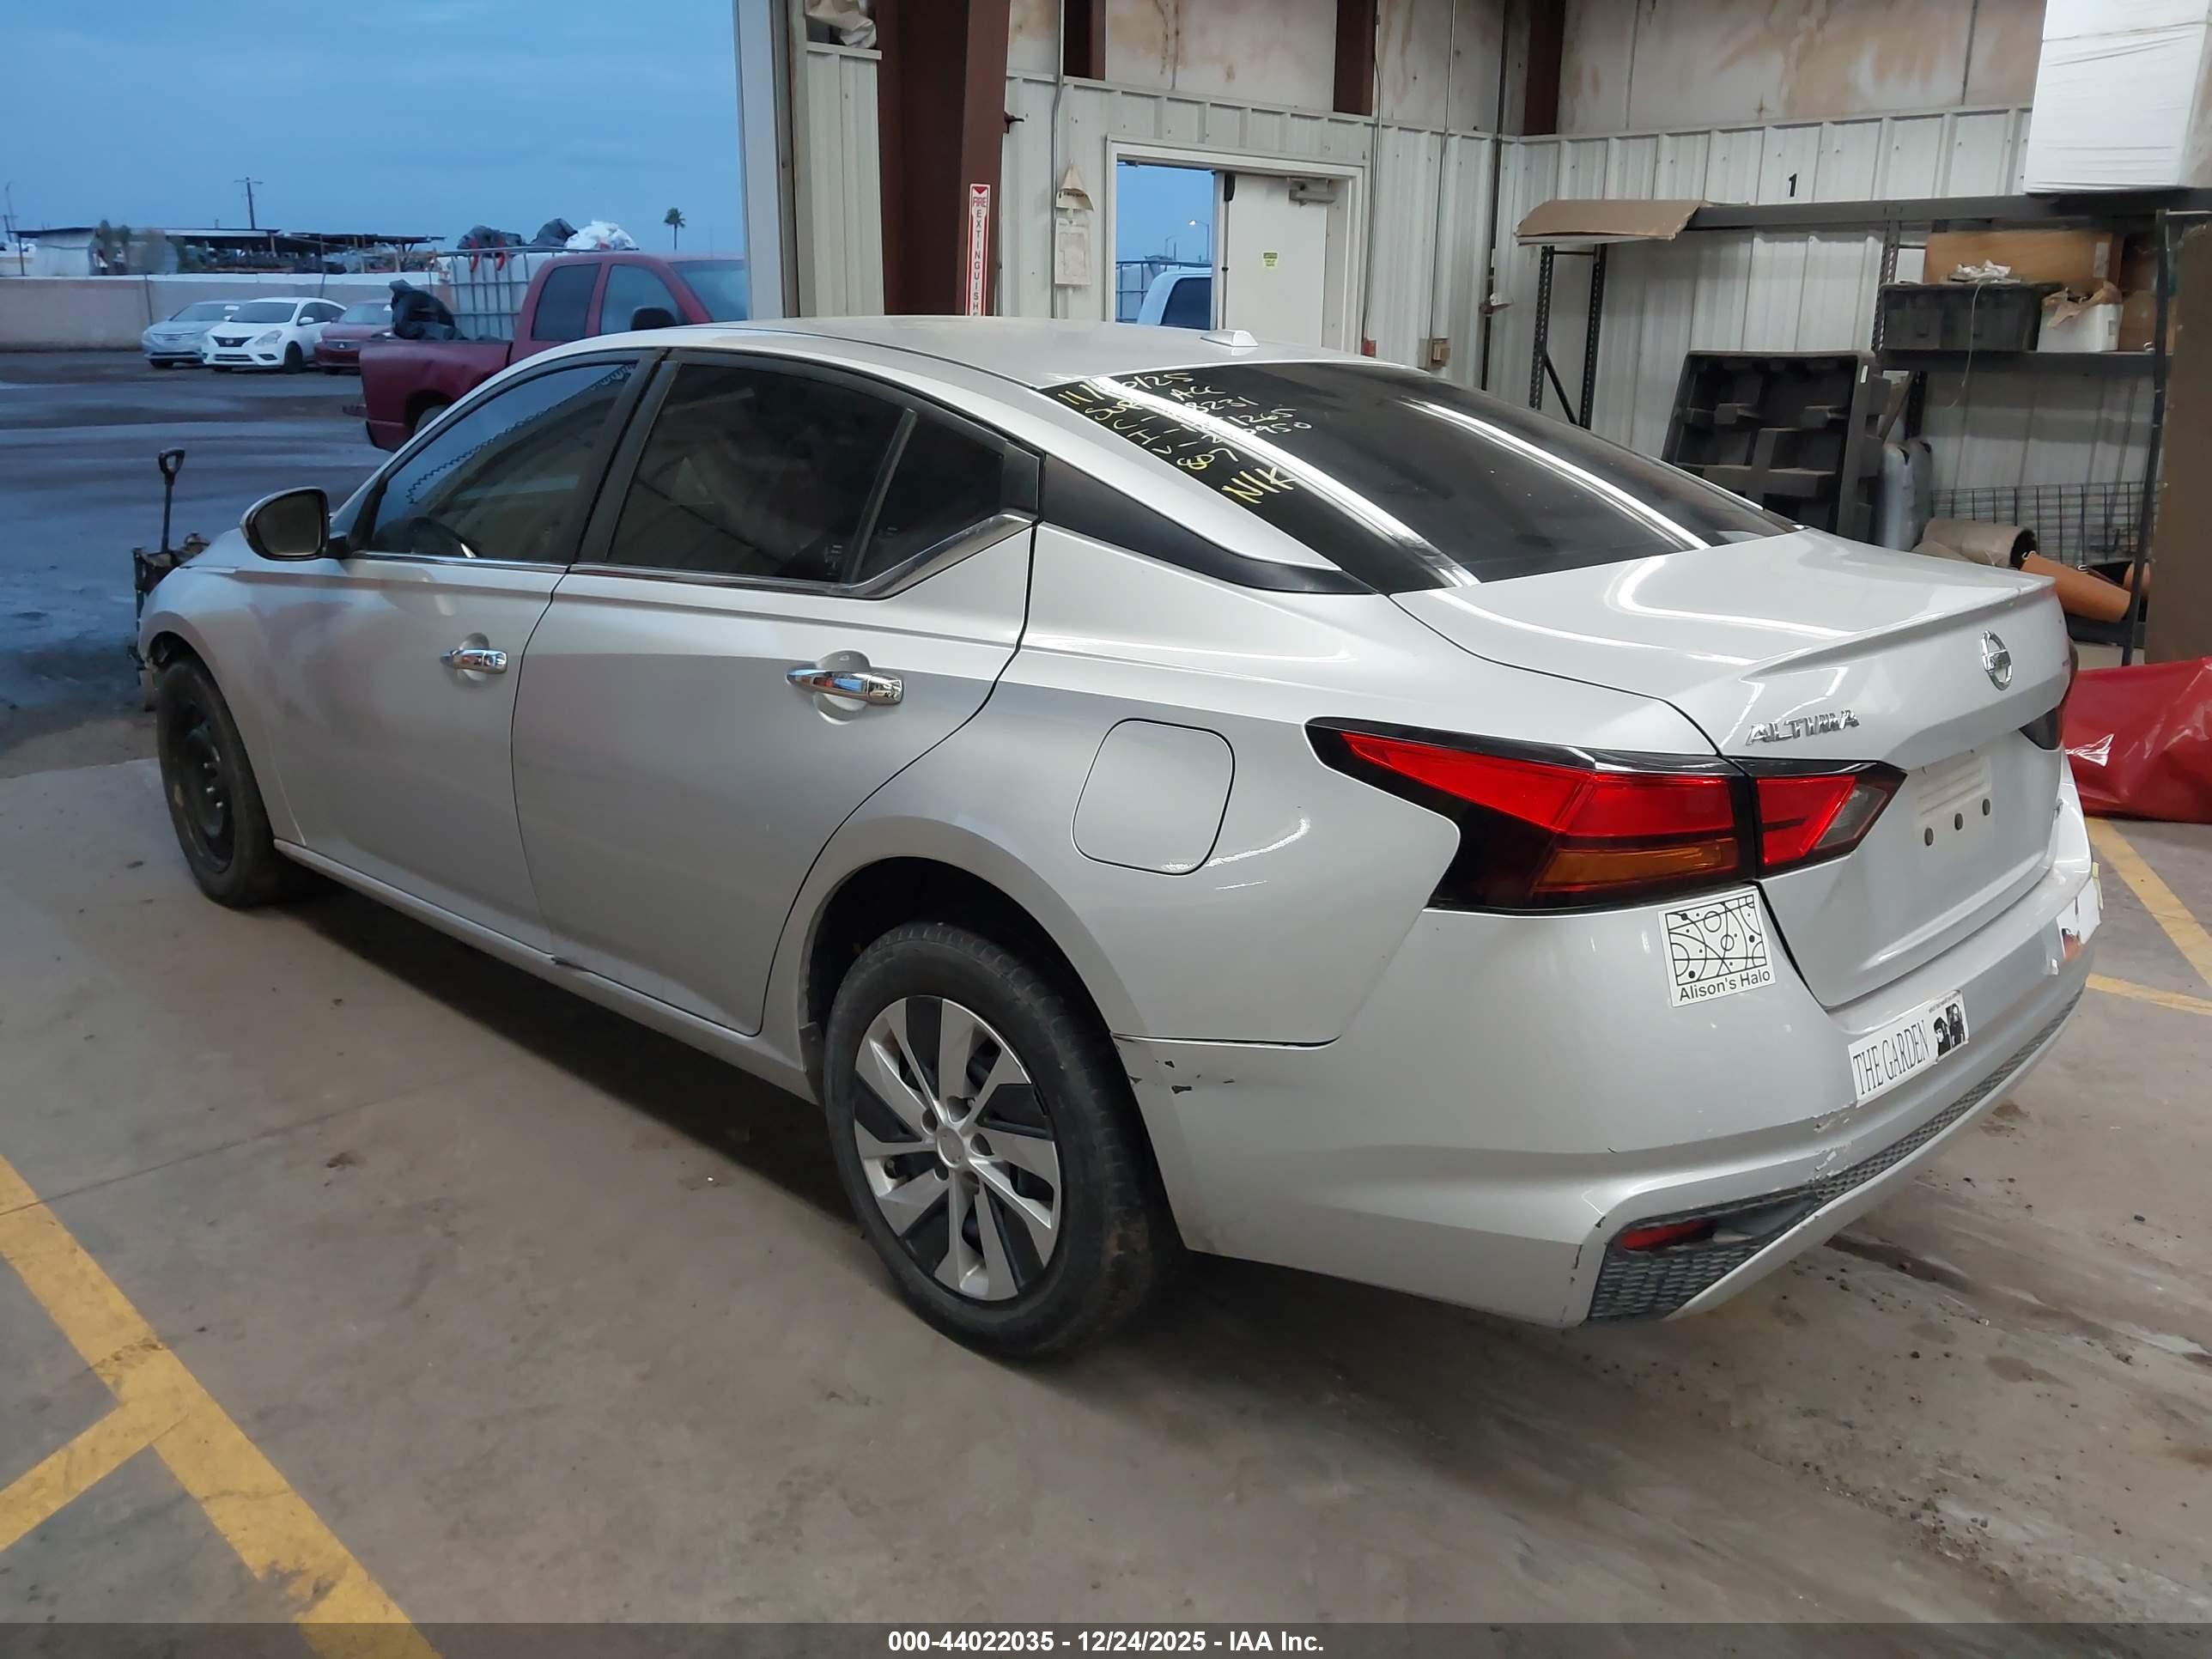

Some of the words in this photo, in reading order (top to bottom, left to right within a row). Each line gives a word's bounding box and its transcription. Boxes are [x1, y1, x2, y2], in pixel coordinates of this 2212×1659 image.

[1789, 173, 1797, 198] 1
[972, 197, 987, 208] FIRE
[1745, 708, 1860, 746] ALTIMA
[1679, 977, 1737, 1001] Alison's
[1740, 969, 1771, 988] Halo
[1852, 1045, 1884, 1096] THE
[1882, 1019, 1930, 1081] GARDEN
